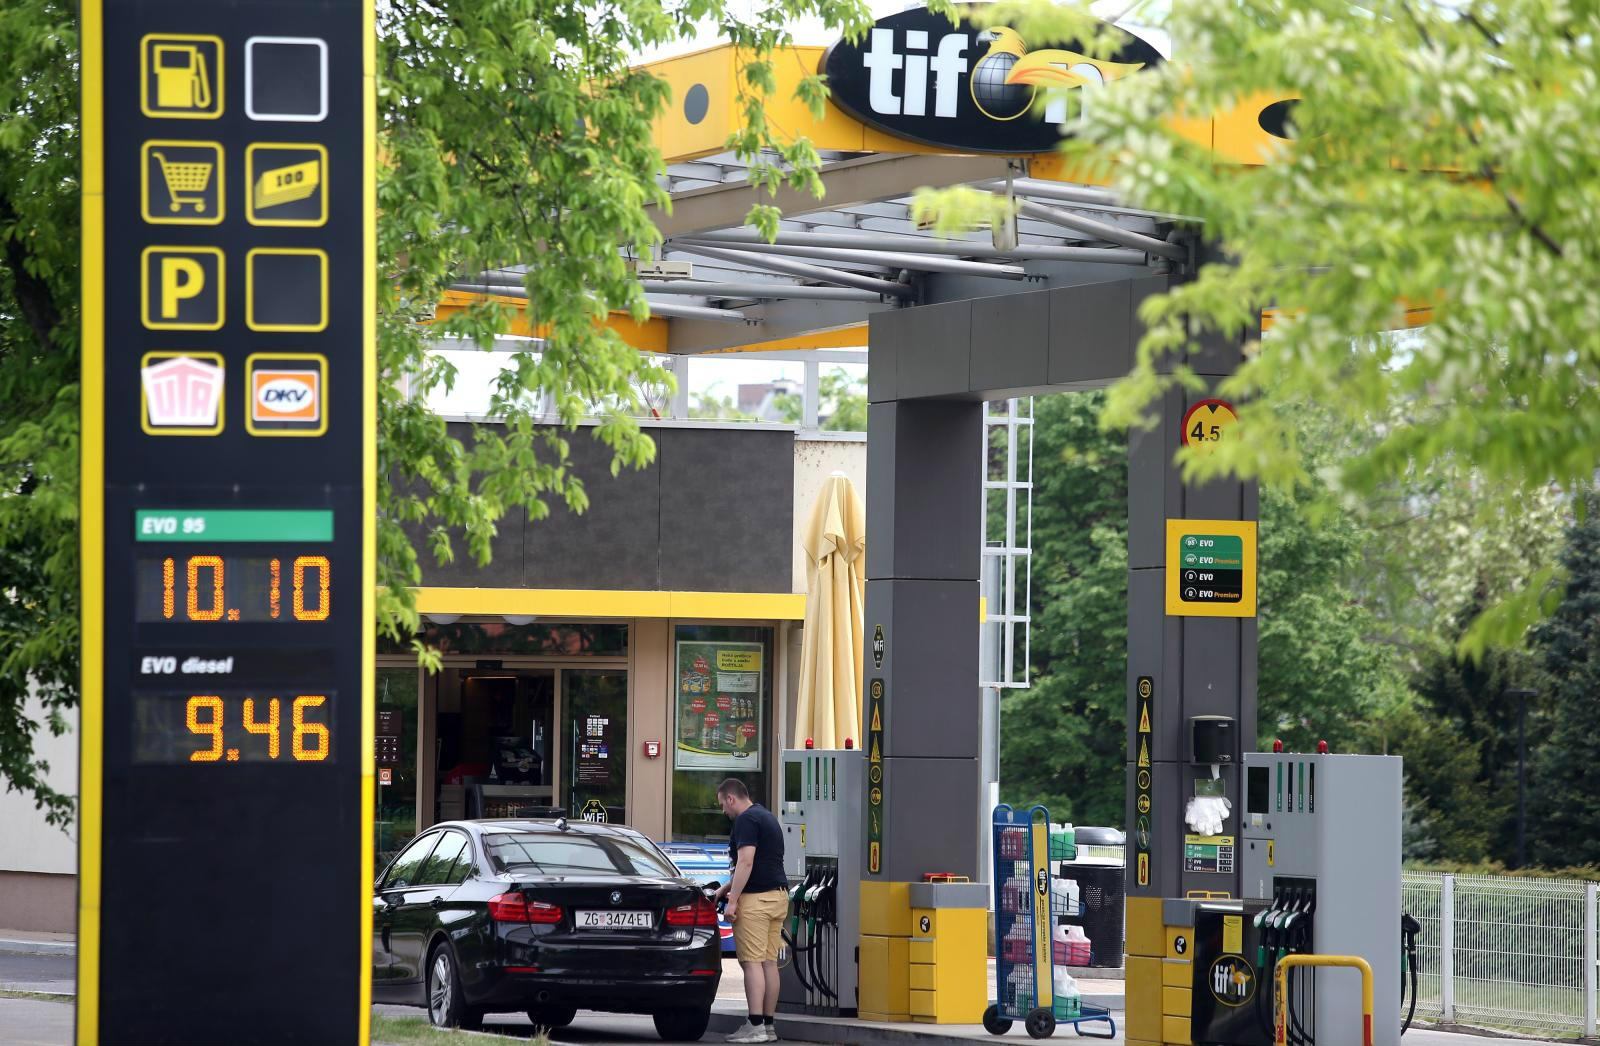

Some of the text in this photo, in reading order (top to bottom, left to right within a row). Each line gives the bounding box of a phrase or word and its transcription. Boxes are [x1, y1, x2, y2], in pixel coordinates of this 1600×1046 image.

[275, 169, 304, 187] 100
[161, 257, 205, 319] P
[150, 360, 217, 419] UTA
[262, 387, 308, 404] DKV
[141, 517, 205, 534] EVO 95
[163, 555, 330, 621] 10.10
[141, 657, 233, 673] EVO diesel
[186, 695, 330, 762] 9.46
[584, 912, 599, 926] ZG
